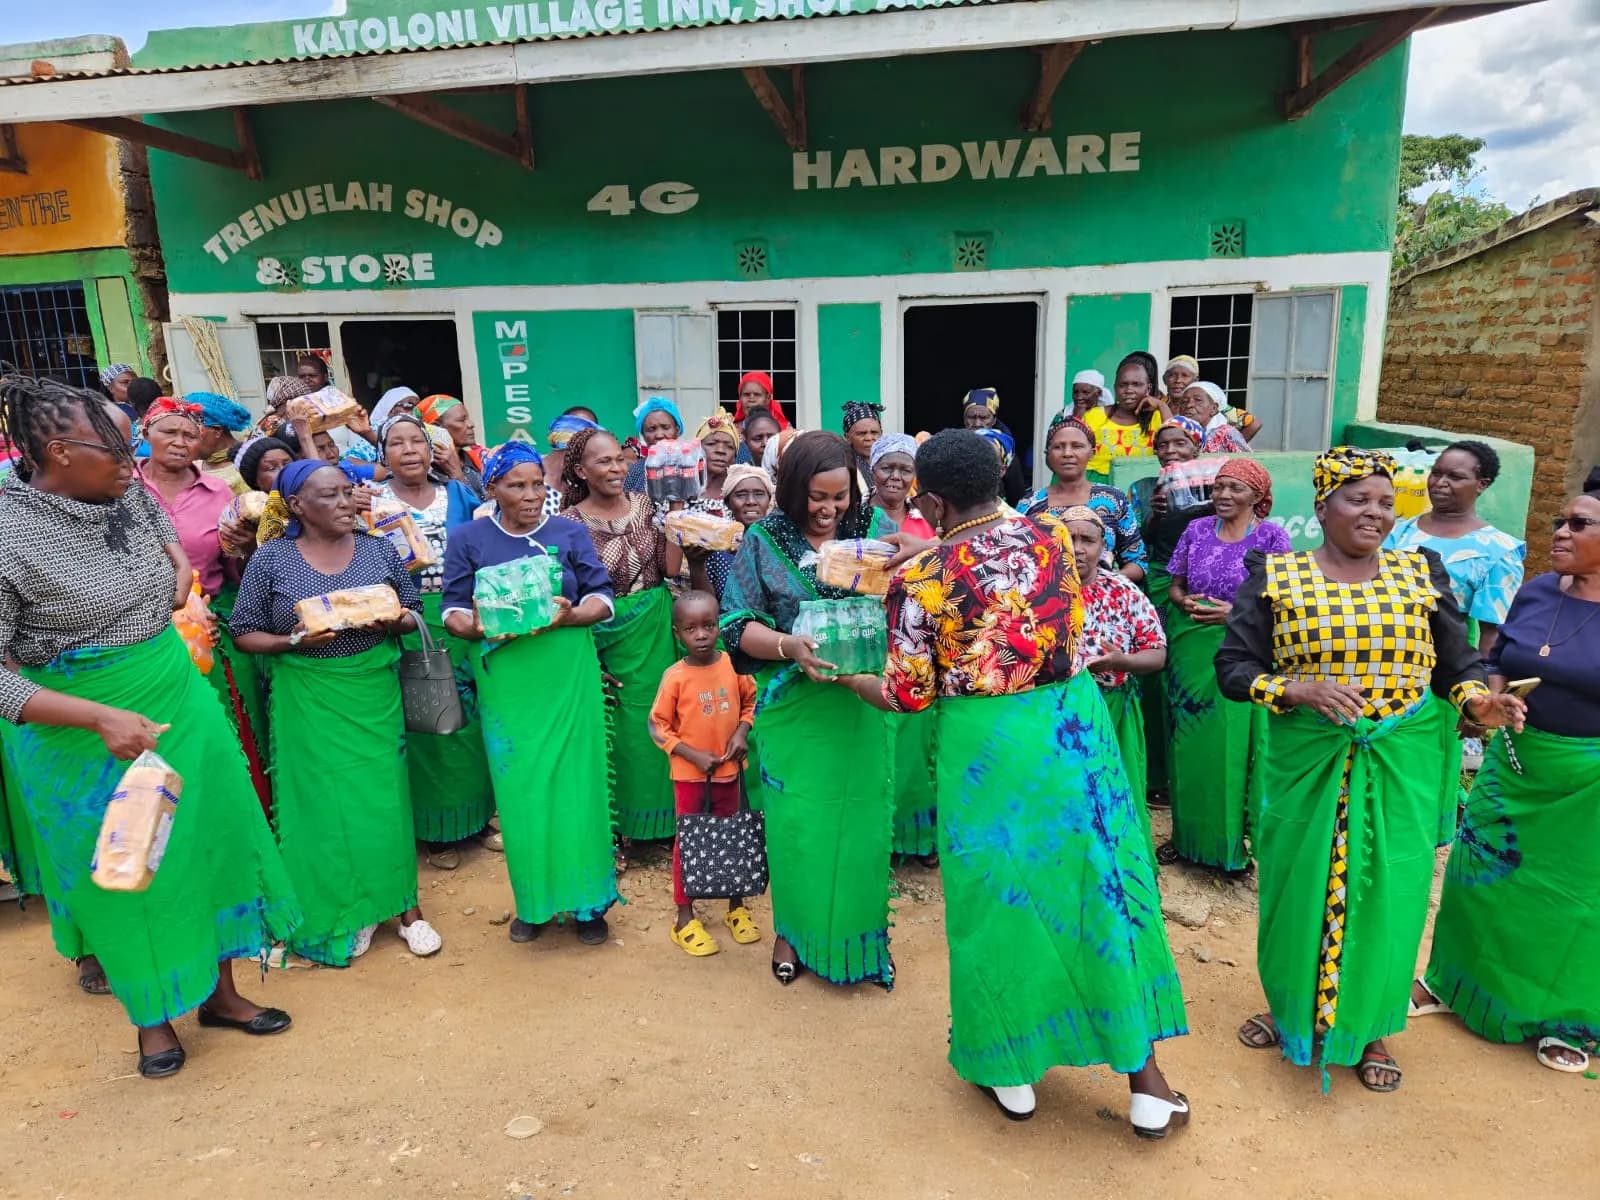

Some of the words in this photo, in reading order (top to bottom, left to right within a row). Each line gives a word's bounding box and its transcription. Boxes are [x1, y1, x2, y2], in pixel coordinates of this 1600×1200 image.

[293, 8, 478, 55] KATOLONI
[486, 0, 644, 37] VILLAGE
[754, 0, 852, 17] SHO
[792, 131, 1142, 191] HARDWARE
[203, 181, 393, 264] TRENUELAH
[404, 189, 503, 248] SHOP
[586, 181, 700, 216] 4G
[256, 257, 286, 285] &
[302, 253, 435, 284] STORE
